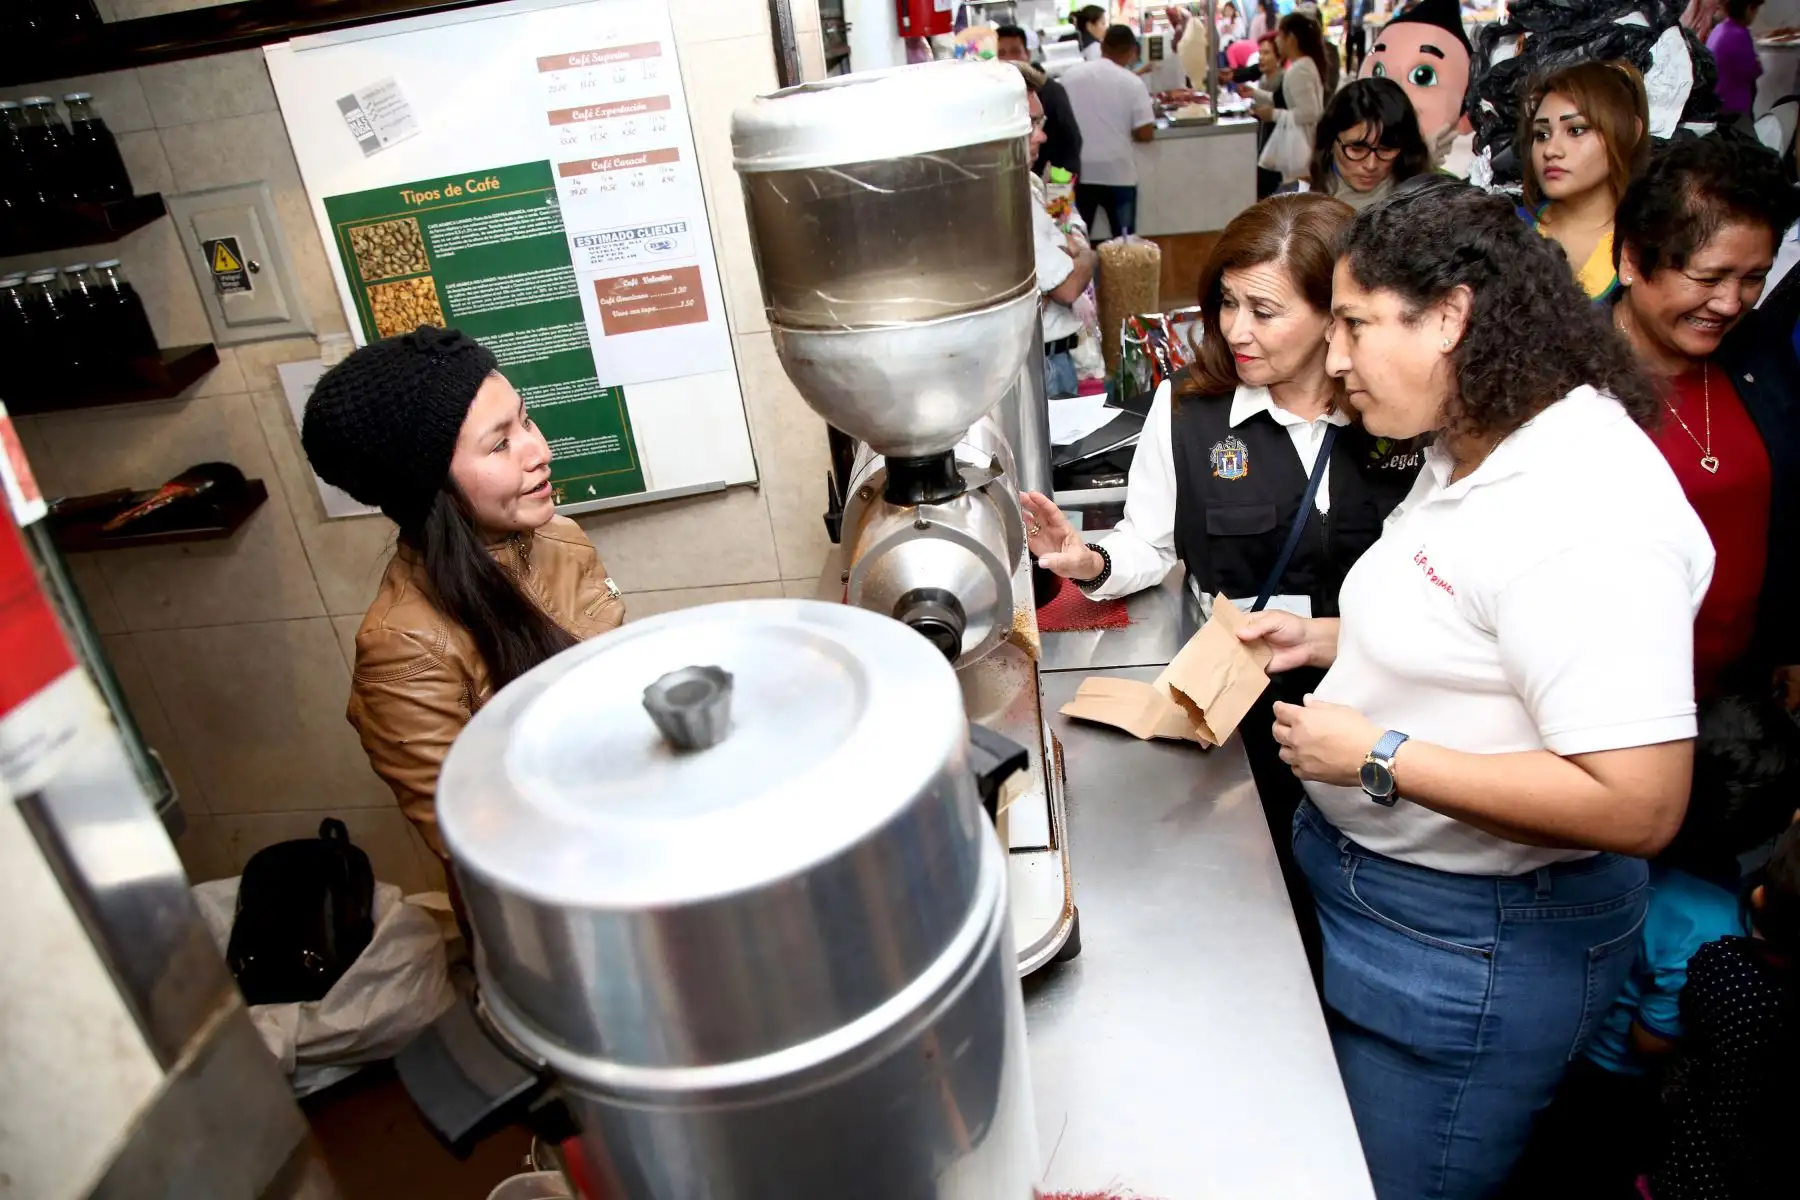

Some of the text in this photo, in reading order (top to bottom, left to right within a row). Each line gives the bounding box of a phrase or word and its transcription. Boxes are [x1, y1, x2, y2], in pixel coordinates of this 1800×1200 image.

[568, 53, 590, 66] Café
[572, 107, 592, 120] Café
[591, 153, 647, 172] Café Caracol
[400, 175, 500, 205] Tipos de Café
[575, 230, 634, 247] ESTIMADO
[636, 222, 686, 238] CLIENTE
